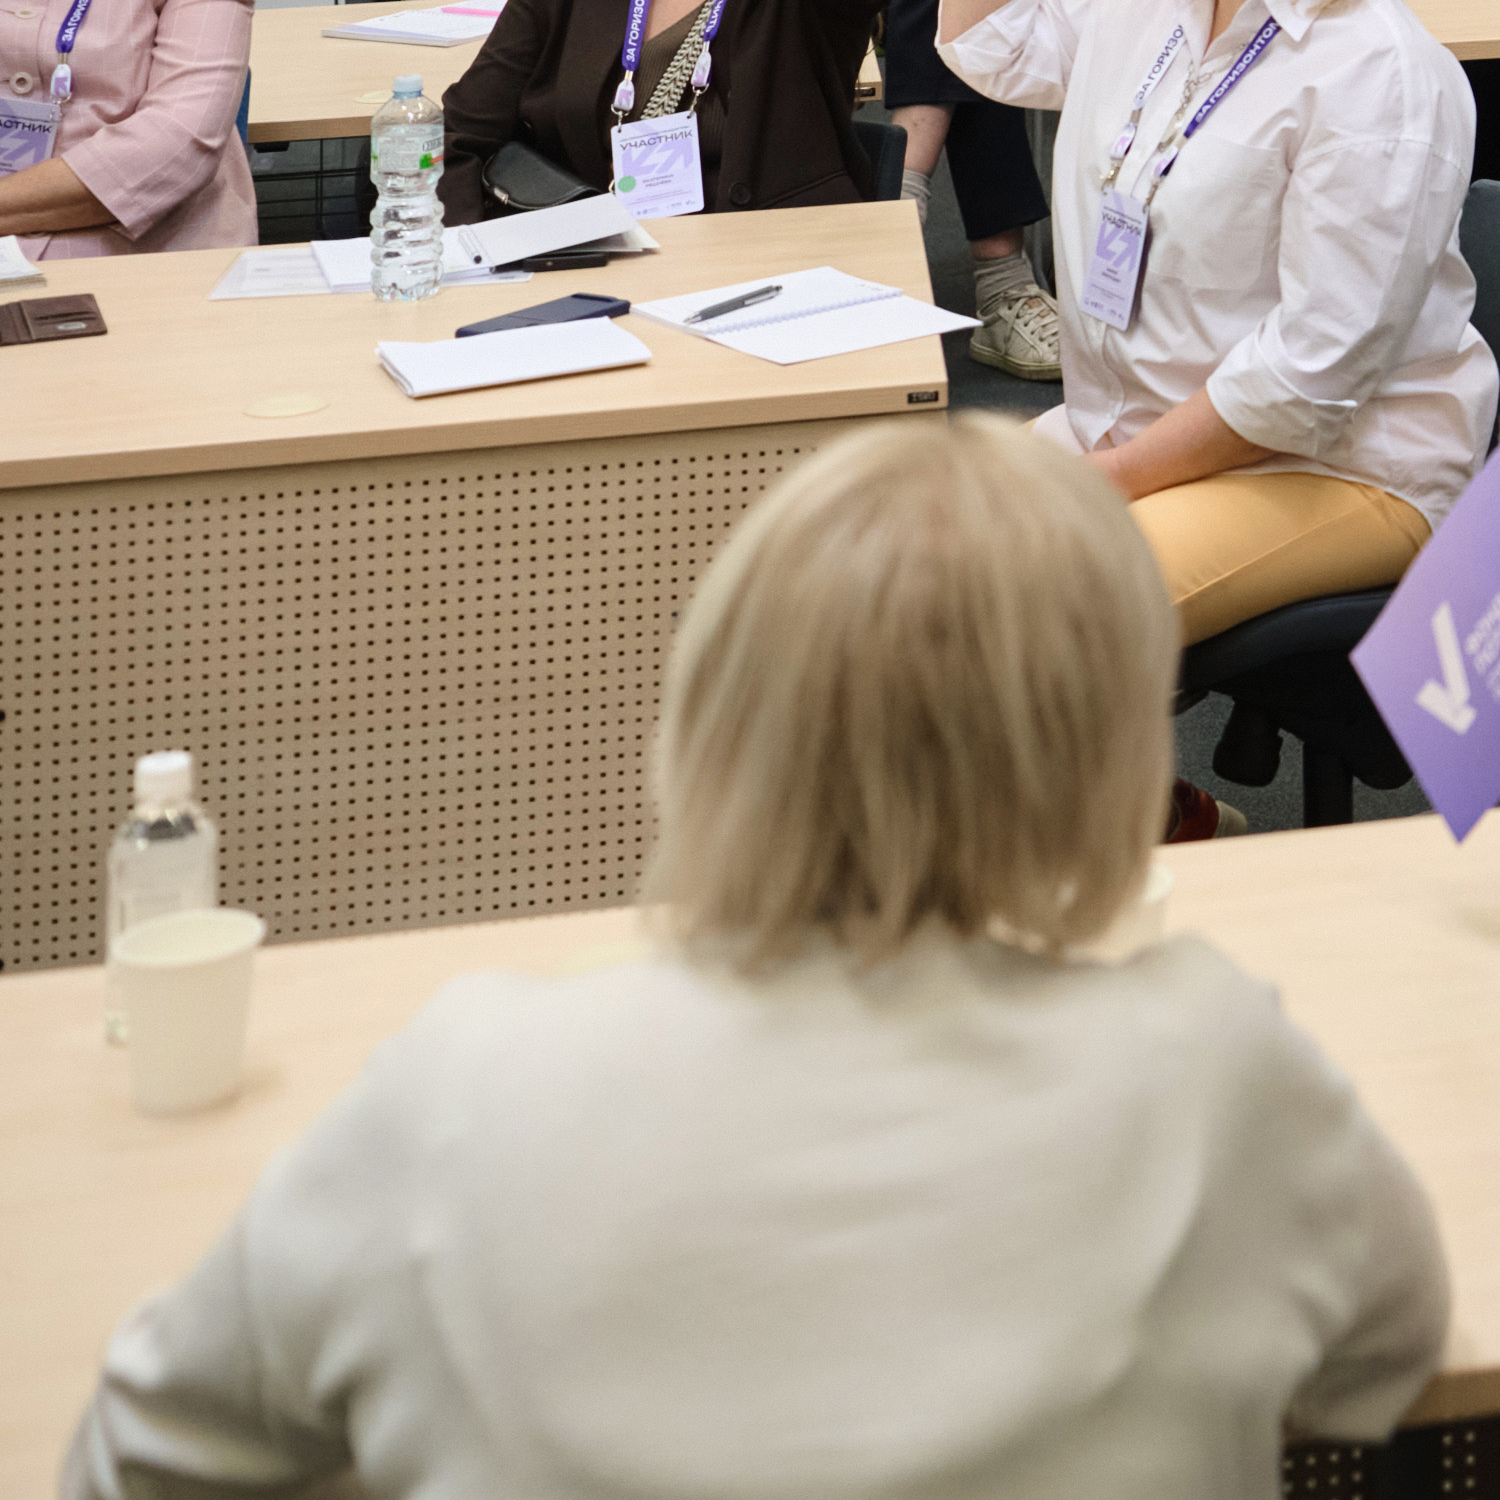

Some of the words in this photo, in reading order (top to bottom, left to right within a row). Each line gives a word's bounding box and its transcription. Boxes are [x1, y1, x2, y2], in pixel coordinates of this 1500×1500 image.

[62, 24, 76, 41] ЗА
[626, 46, 637, 62] ЗА
[1135, 82, 1151, 101] ЗА
[1194, 103, 1213, 123] ЗА
[620, 129, 693, 151] УЧАСТНИК
